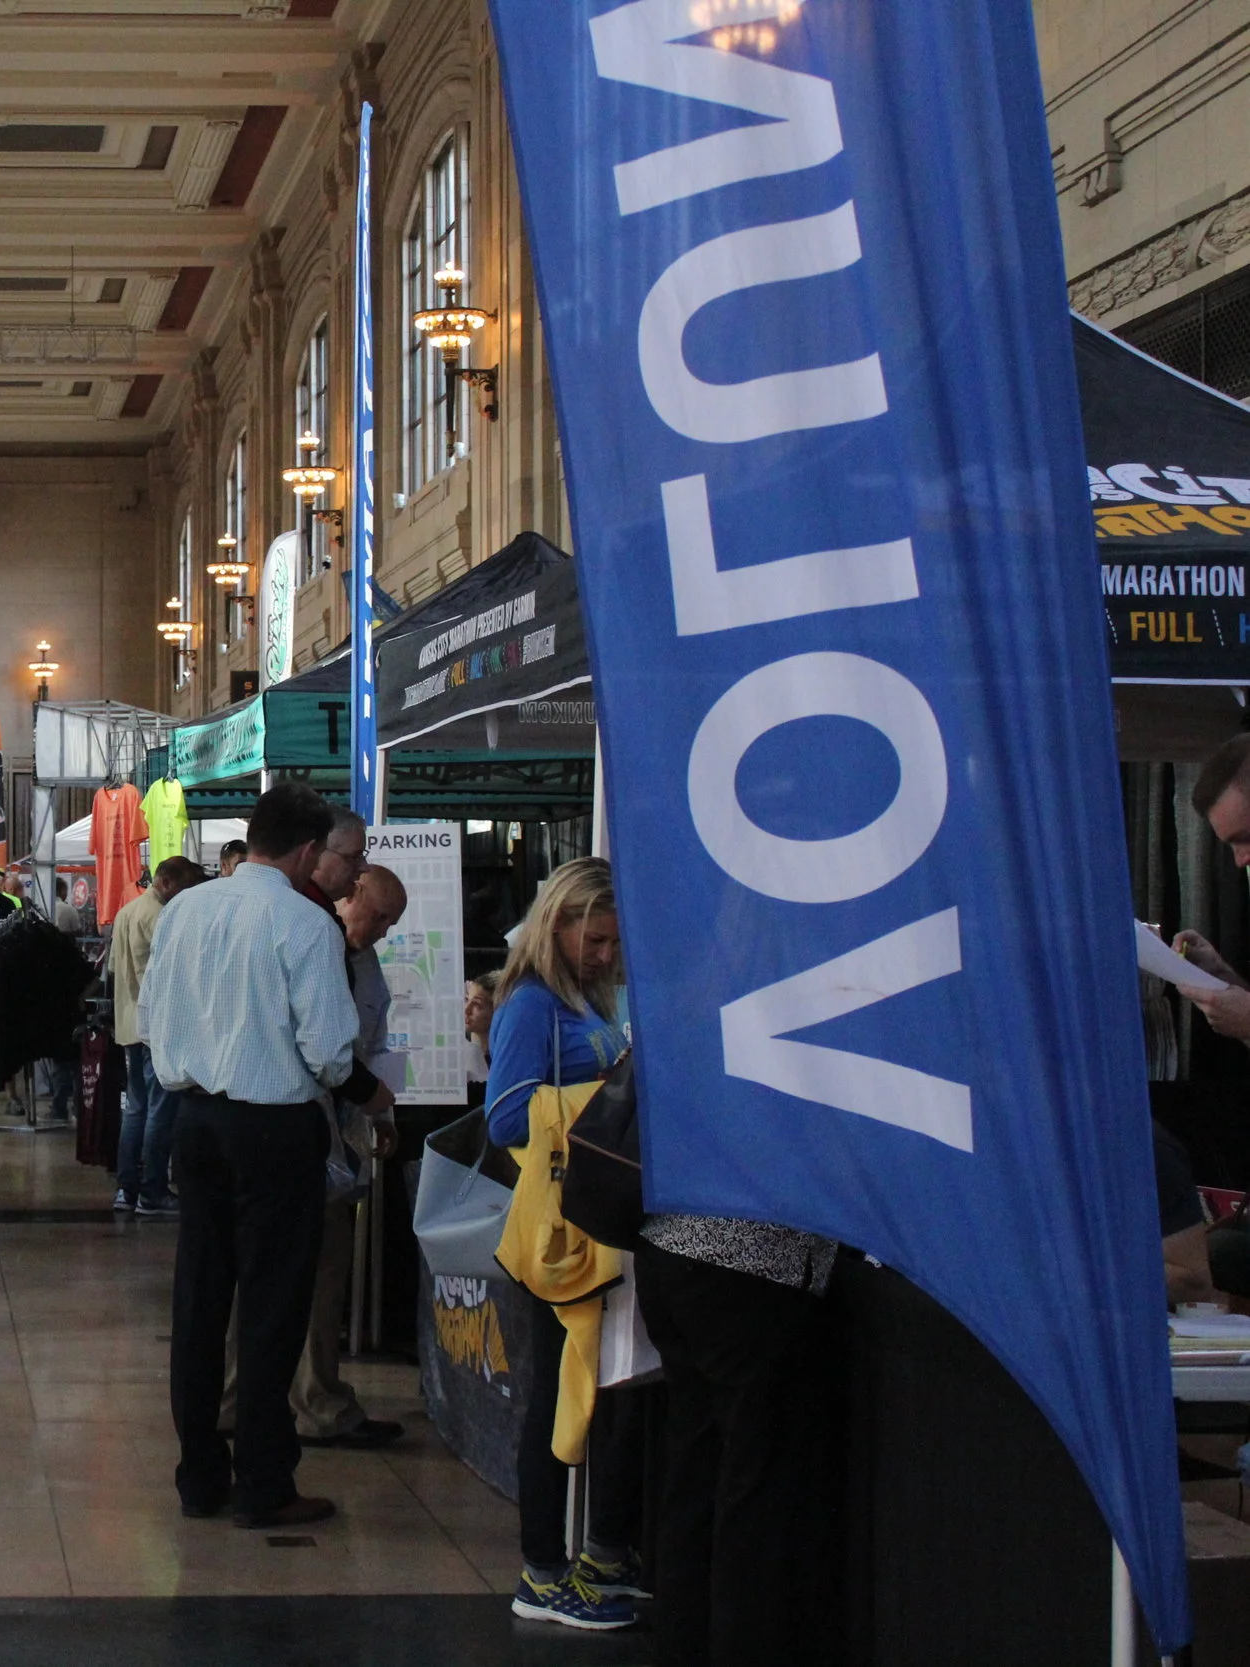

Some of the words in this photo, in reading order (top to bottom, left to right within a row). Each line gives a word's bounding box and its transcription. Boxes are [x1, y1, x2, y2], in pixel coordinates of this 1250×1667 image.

[1094, 503, 1250, 538] ATHO
[1101, 564, 1245, 597] MARATHON
[1129, 611, 1203, 643] FULL
[368, 833, 452, 850] PARKING
